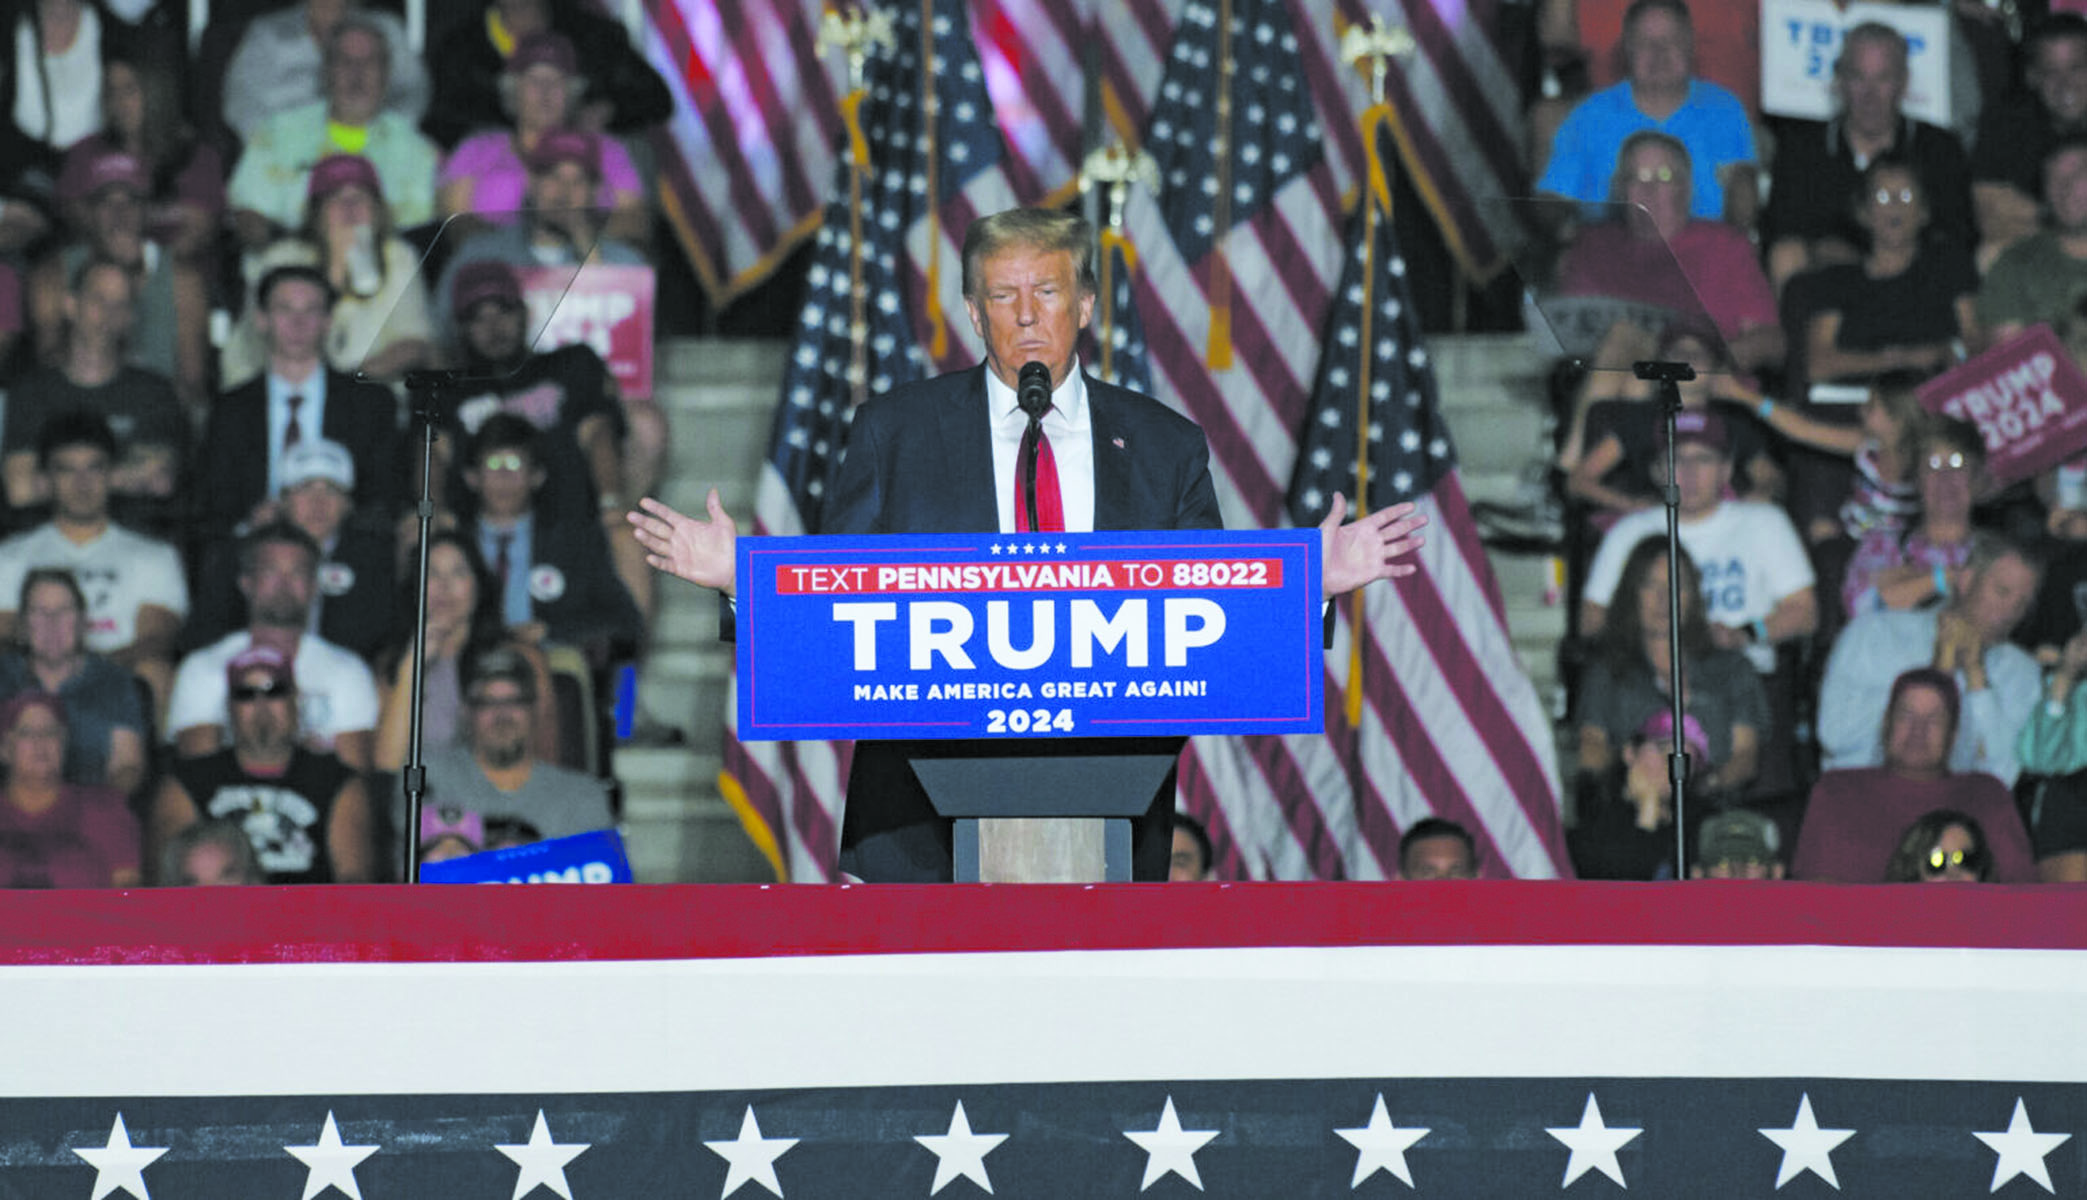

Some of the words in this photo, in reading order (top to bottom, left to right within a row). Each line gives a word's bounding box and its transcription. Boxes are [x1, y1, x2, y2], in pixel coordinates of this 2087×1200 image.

[1978, 389, 2066, 451] 2024
[791, 567, 870, 592] TEXT
[878, 563, 1115, 590] PENNSYLVANIA
[1122, 563, 1164, 588] TO
[1172, 561, 1268, 587] 88022
[832, 597, 1227, 671] TRUMP
[854, 683, 919, 701] MAKE
[927, 682, 1033, 700] AMERICA
[1040, 681, 1117, 699] GREAT
[1124, 680, 1207, 697] AGAIN!
[987, 708, 1075, 733] 2024
